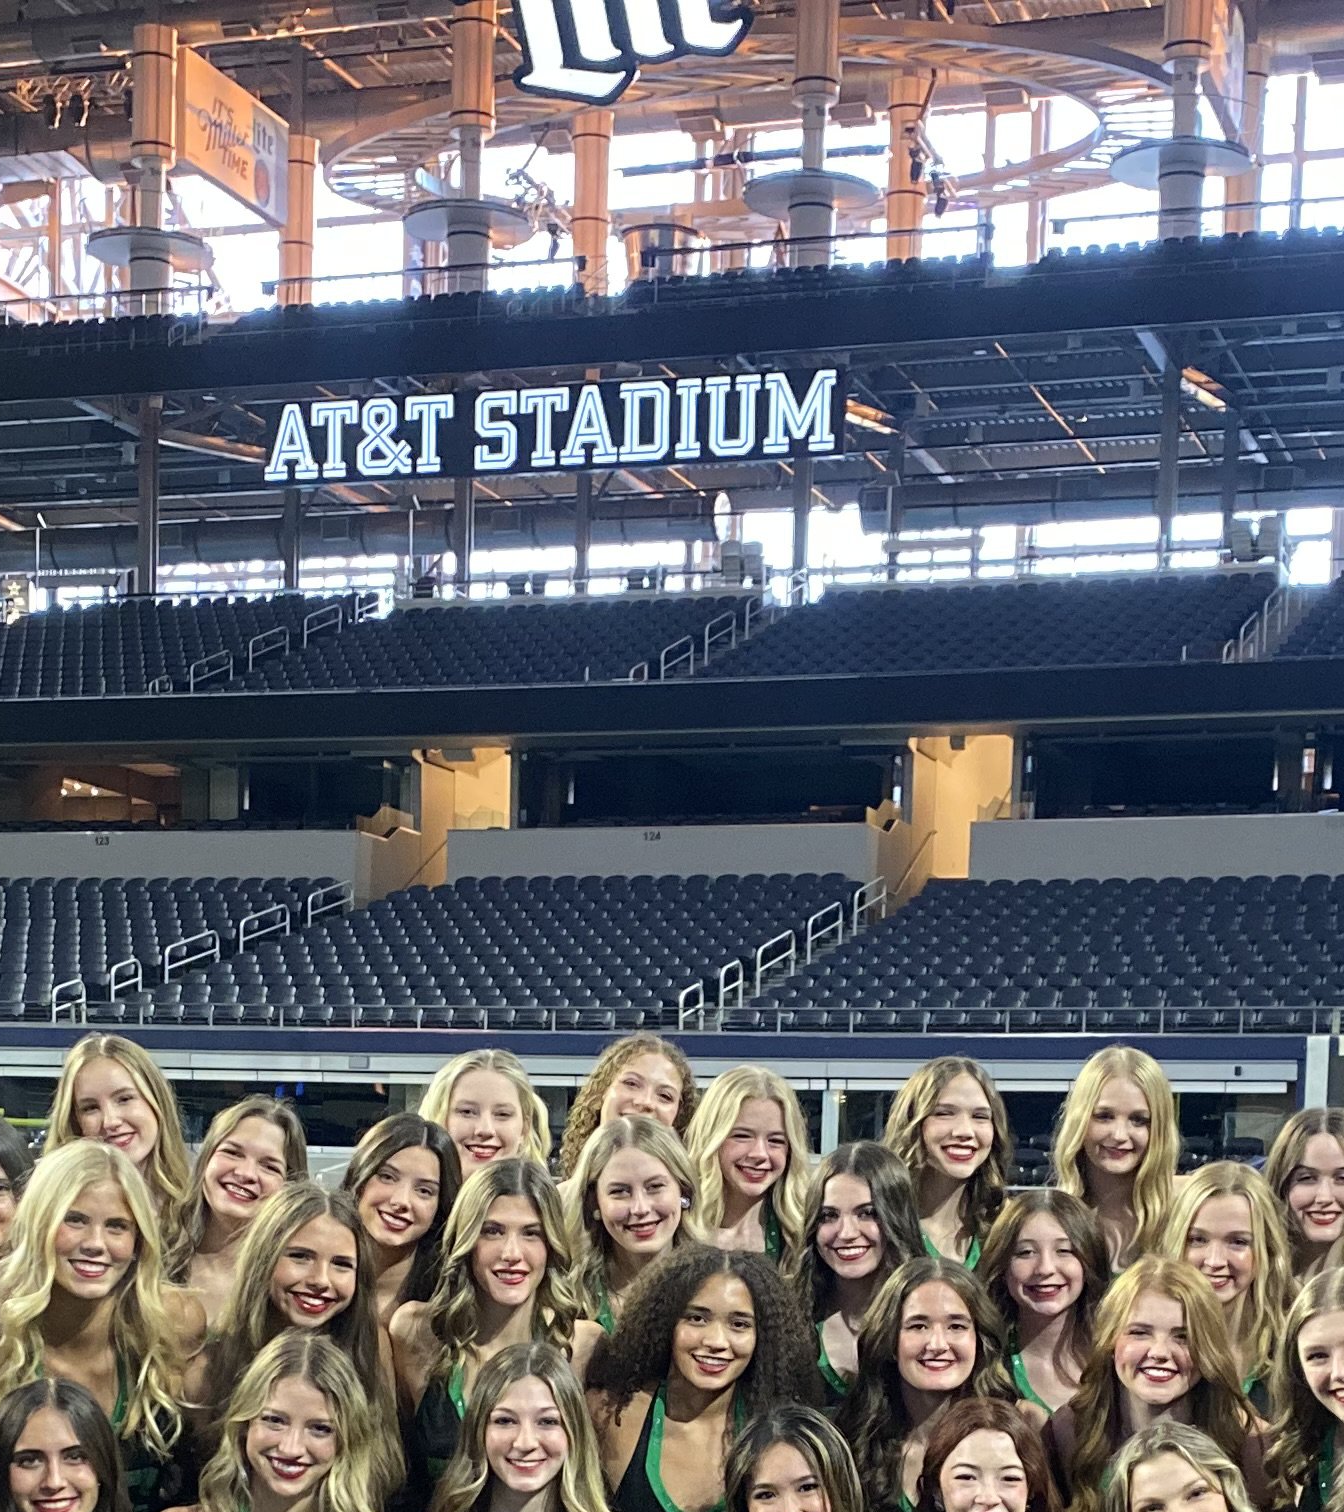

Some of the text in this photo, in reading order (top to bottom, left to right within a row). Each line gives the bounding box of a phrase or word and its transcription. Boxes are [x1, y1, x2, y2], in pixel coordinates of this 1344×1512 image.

[213, 97, 234, 124] IT'S
[197, 109, 250, 152] Miller
[222, 148, 249, 181] TIME
[264, 368, 838, 482] AT&T STADIUM
[643, 831, 662, 841] 124
